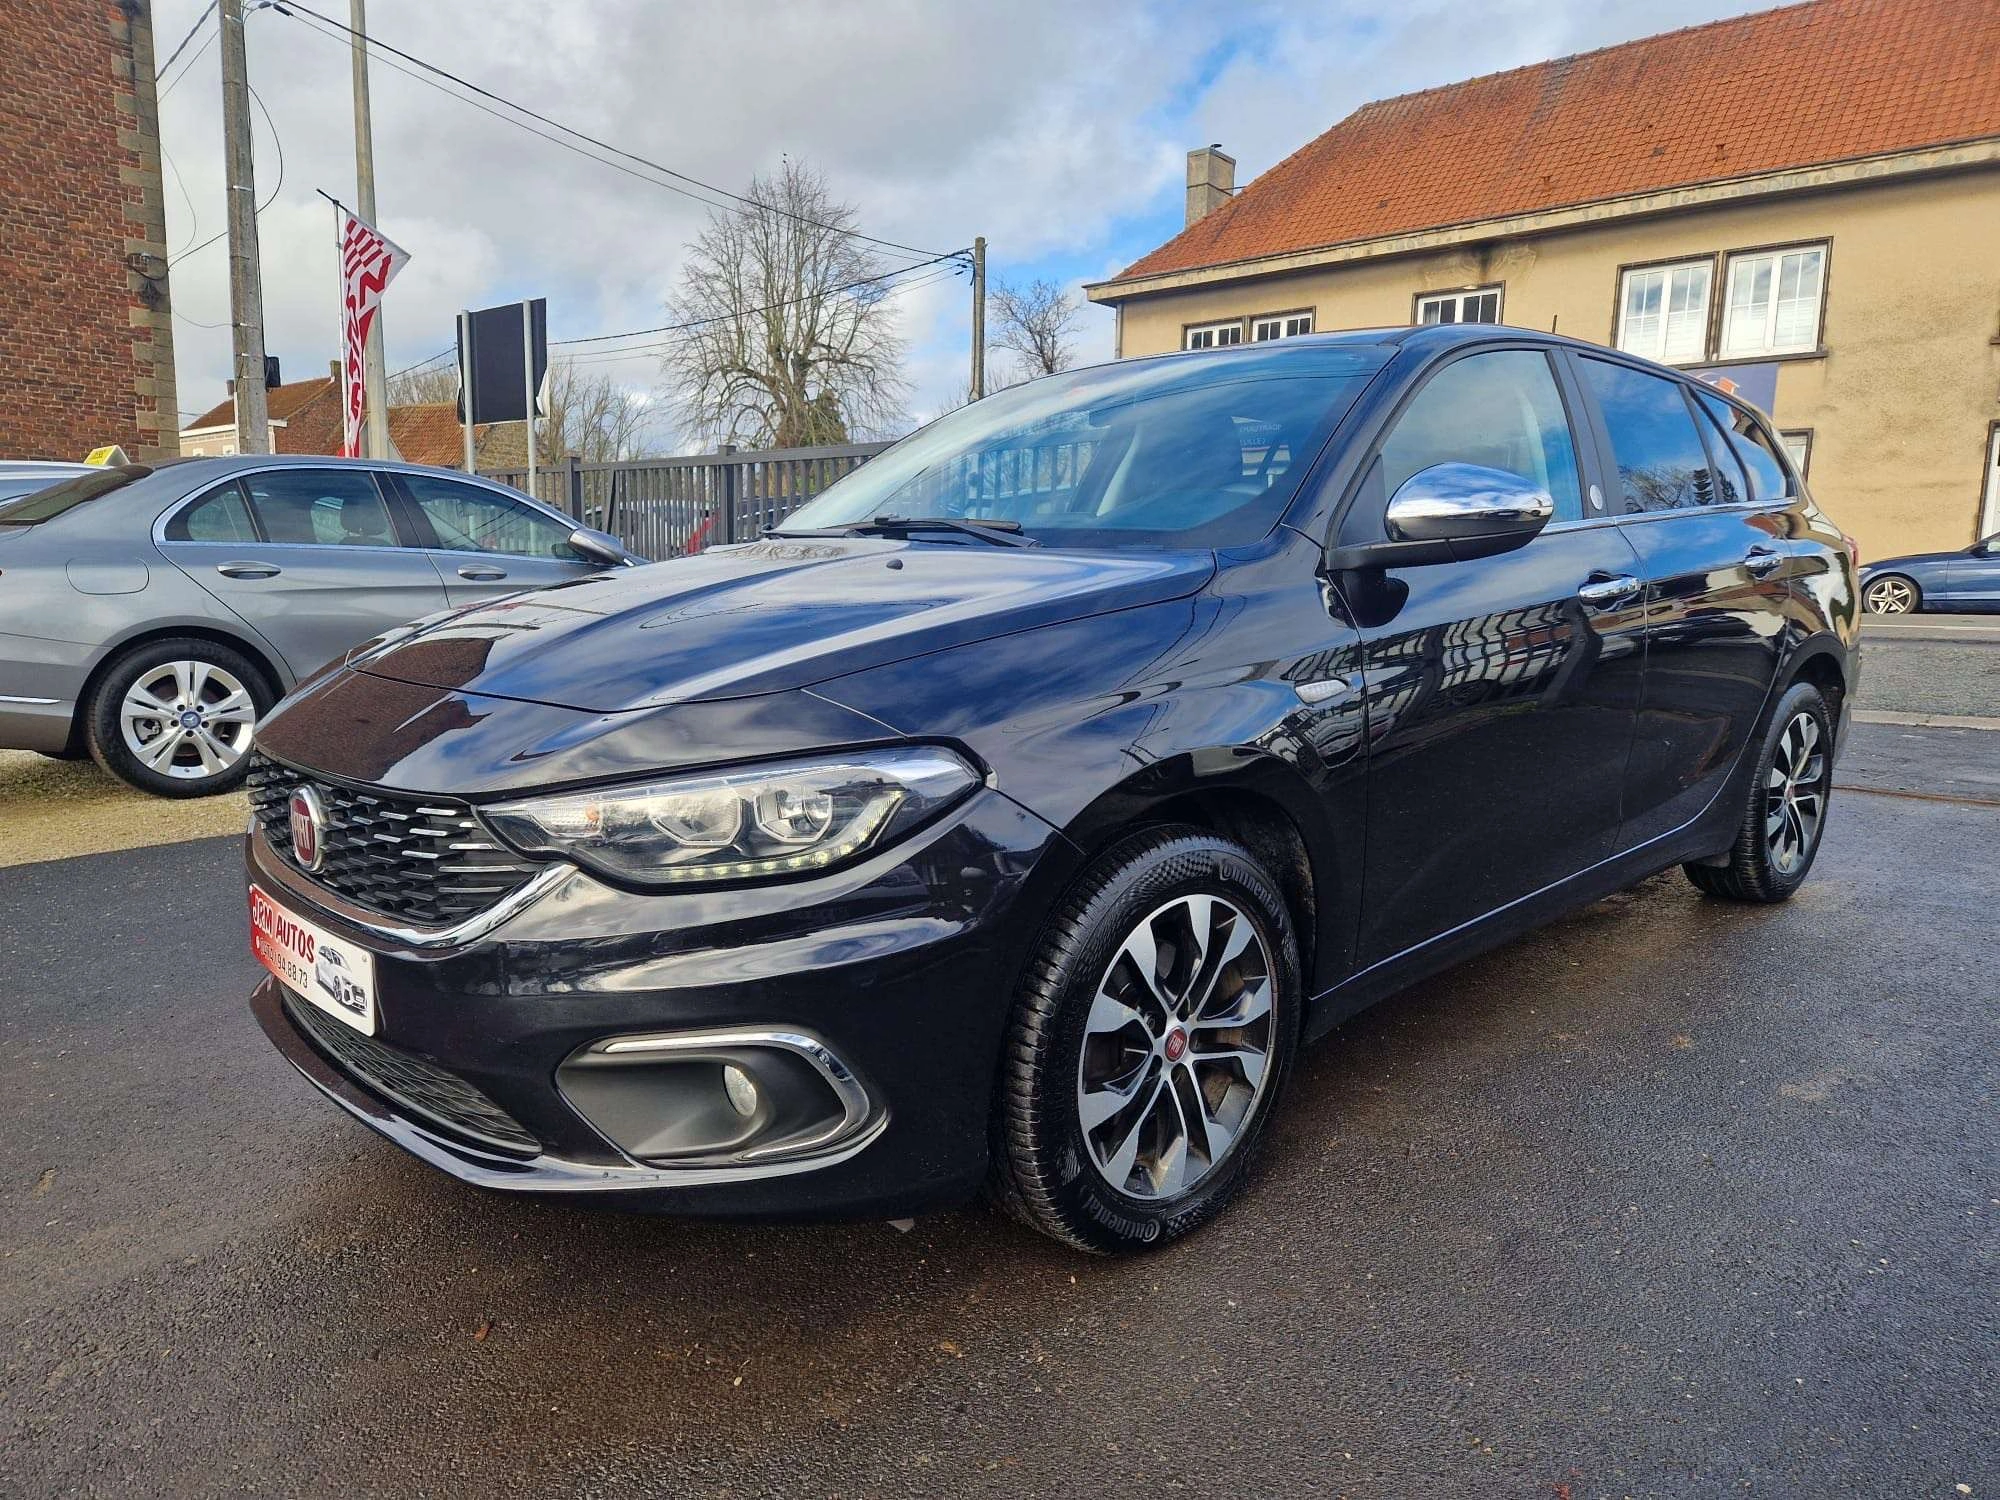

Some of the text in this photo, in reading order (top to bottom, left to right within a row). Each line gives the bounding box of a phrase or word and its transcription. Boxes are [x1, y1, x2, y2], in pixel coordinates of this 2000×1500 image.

[291, 811, 310, 850] FIAT
[275, 913, 315, 964] AUTOS
[1081, 1194, 1161, 1243] Continental
